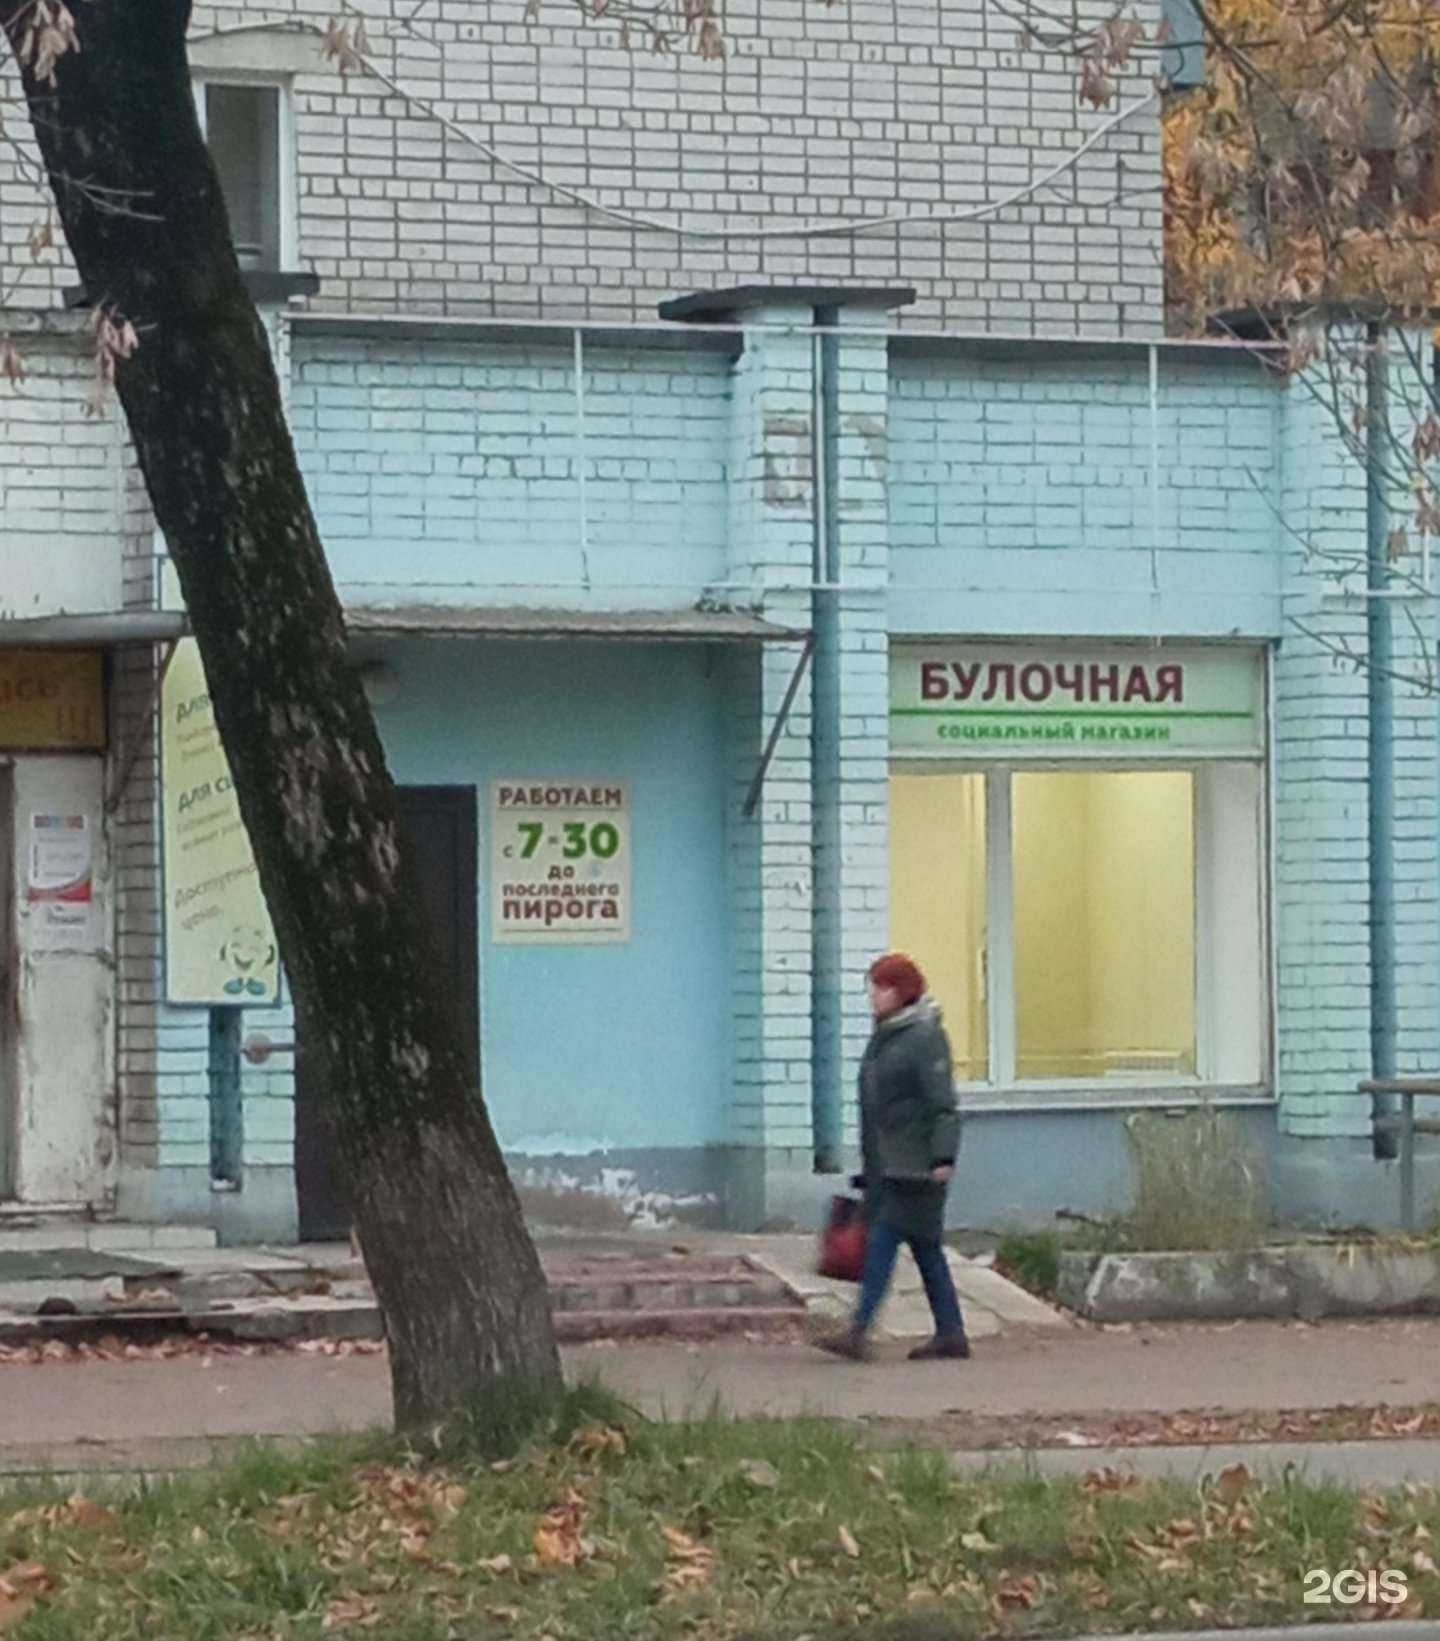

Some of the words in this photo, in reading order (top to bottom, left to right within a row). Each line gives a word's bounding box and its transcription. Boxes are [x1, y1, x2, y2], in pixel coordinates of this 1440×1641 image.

[920, 661, 1184, 703] БУЛОЧНАЯ
[937, 721, 1075, 741] социальный
[1080, 725, 1171, 741] магазин
[499, 787, 622, 806] РАБОТАЕМ
[548, 865, 575, 880] до
[502, 882, 620, 898] последнего
[502, 899, 619, 926] пирога
